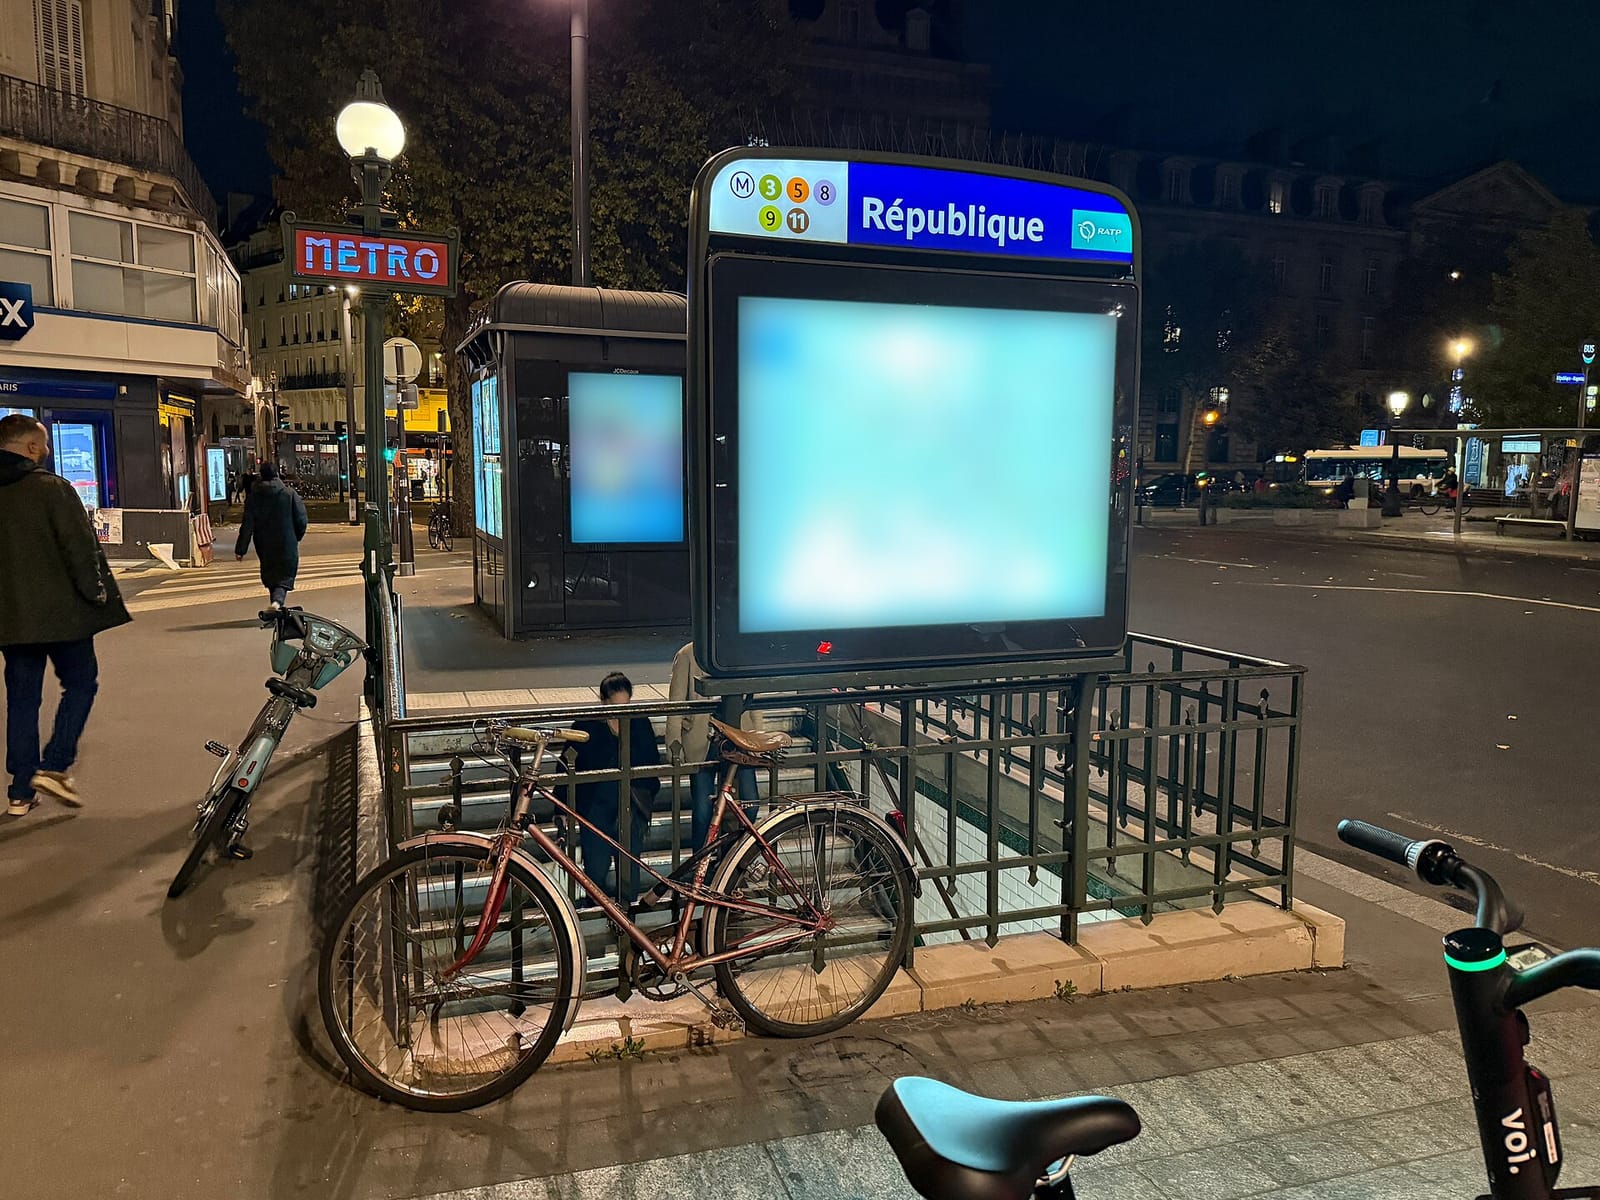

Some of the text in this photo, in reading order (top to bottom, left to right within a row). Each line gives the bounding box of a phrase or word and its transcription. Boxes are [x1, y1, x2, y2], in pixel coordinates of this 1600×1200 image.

[765, 179, 776, 196] 3
[793, 183, 803, 198] 5
[819, 185, 830, 201] 8
[765, 210, 805, 230] 9 11
[862, 196, 1044, 247] République
[1097, 227, 1122, 236] RATP
[305, 236, 439, 279] METRO
[0, 297, 28, 328] X
[1583, 344, 1596, 353] BUS
[1501, 1107, 1536, 1174] voi.
